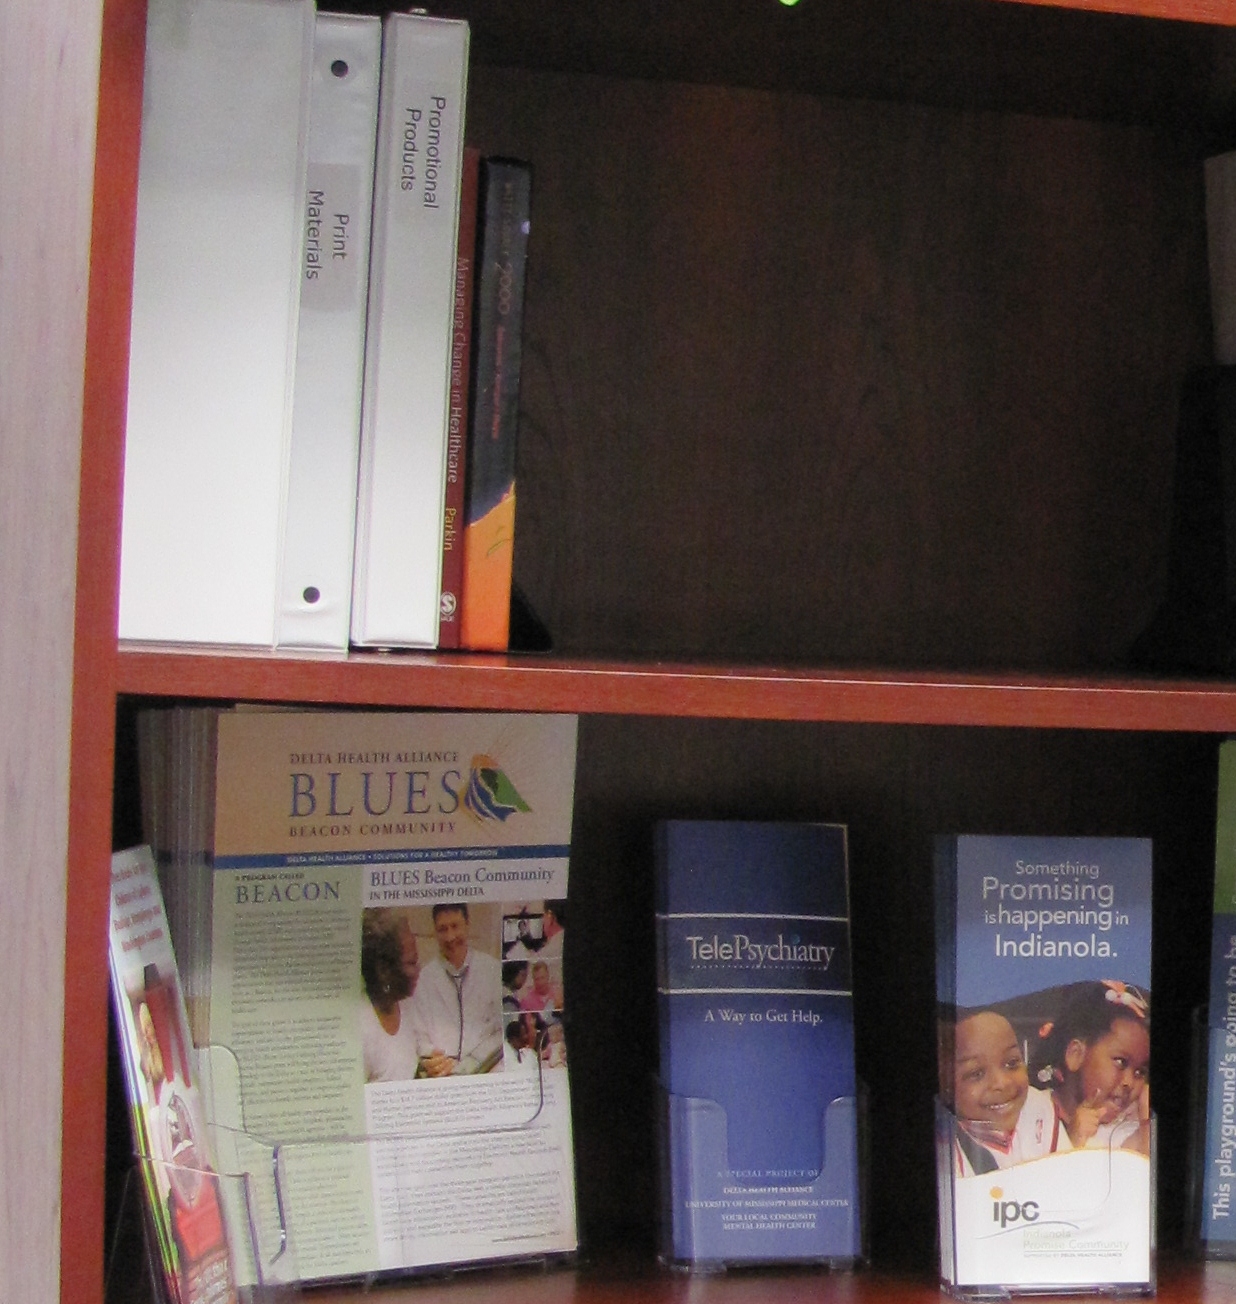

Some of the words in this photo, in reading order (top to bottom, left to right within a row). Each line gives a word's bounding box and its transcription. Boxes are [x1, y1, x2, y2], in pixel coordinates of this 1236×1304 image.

[401, 108, 422, 190] Products
[424, 96, 446, 208] Promotional
[306, 190, 324, 280] Materials
[333, 214, 349, 259] Print
[453, 258, 469, 329] Managing
[452, 332, 468, 386] Change
[452, 390, 463, 404] in
[448, 407, 463, 483] Healthcare
[444, 507, 456, 550] Parkin
[290, 753, 331, 764] DELTA
[337, 752, 390, 764] HEALTH
[395, 751, 459, 763] ALLIANCE
[289, 769, 461, 818] BLUES
[289, 825, 350, 838] BEACON
[360, 822, 456, 836] COMMUNITY
[371, 870, 420, 886] BLUES
[425, 869, 470, 884] Beacon
[476, 866, 554, 884] Community
[1016, 860, 1100, 880] Something
[236, 881, 340, 904] BEACON
[370, 891, 380, 900] IN
[384, 890, 400, 900] THE
[404, 888, 455, 898] MISSISSIPPI
[457, 886, 484, 896] DELTA
[982, 876, 1114, 908] Promising
[984, 910, 996, 924] is
[998, 903, 1112, 931] happening
[1115, 911, 1129, 925] in
[686, 934, 834, 970] TelePsychiatry
[996, 933, 1118, 958] Indianola.
[704, 1010, 714, 1022] A
[718, 1009, 746, 1025] Way
[750, 1012, 762, 1022] to
[766, 1009, 788, 1022] Get
[792, 1010, 823, 1026] Help.
[990, 1186, 1040, 1228] ipc
[1212, 1183, 1231, 1220] This
